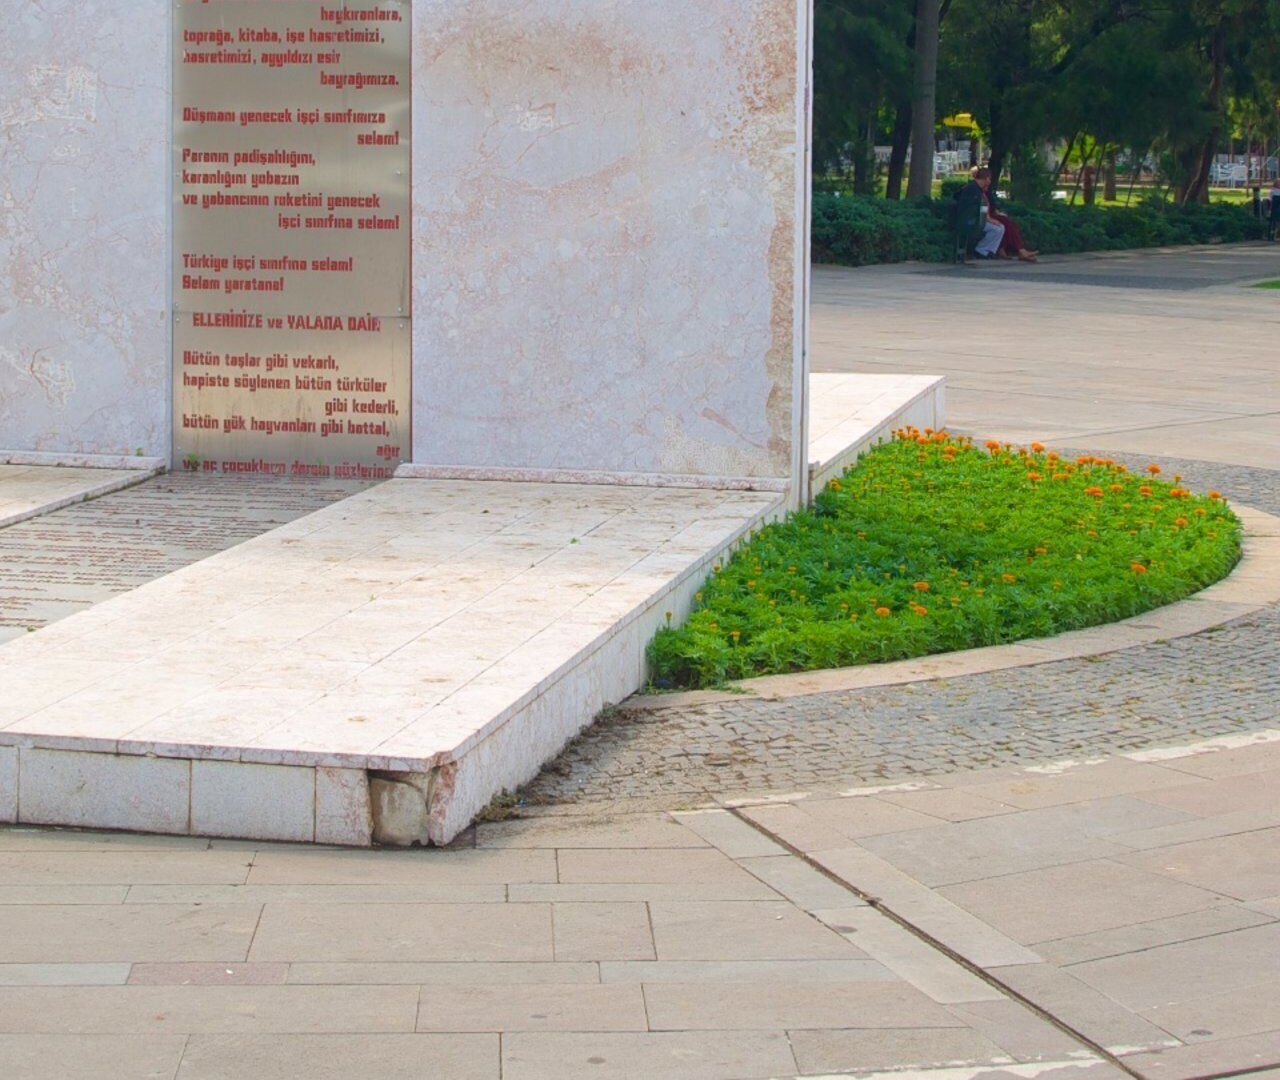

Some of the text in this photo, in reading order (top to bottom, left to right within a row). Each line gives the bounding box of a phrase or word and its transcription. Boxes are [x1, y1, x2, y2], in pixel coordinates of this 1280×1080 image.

[321, 7, 402, 24] haykıranlara,
[184, 29, 233, 46] toprağa,
[239, 28, 281, 43] kitaba,
[286, 28, 304, 43] işe
[261, 50, 312, 67] ayyıldızı
[321, 71, 399, 89] bayrağımıza.
[183, 107, 385, 126] Düşmanı yenecek işçi sınıfımıza
[357, 131, 399, 145] selam!
[182, 148, 315, 167] Paranın padişahlığını,
[182, 170, 246, 188] karanlığını
[183, 194, 197, 205] ve
[202, 192, 269, 208] yabancının
[327, 194, 380, 210] yenecek
[306, 214, 352, 229] sınıfına
[358, 215, 399, 230] selam!
[182, 254, 352, 271] Türkiye işçi sınıfına selam!
[182, 275, 284, 293] Selam yaratana!
[268, 316, 282, 329] ve
[287, 315, 343, 330] YALANA
[183, 351, 220, 366] Bütün
[225, 353, 260, 368] taşlar
[265, 354, 288, 371] gibi
[183, 372, 387, 393] hapiste söylenen bütün türküler
[325, 398, 398, 416] gibi kederli,
[183, 414, 218, 430] bütün
[251, 417, 316, 435] hayvanları
[321, 419, 343, 436] gibi
